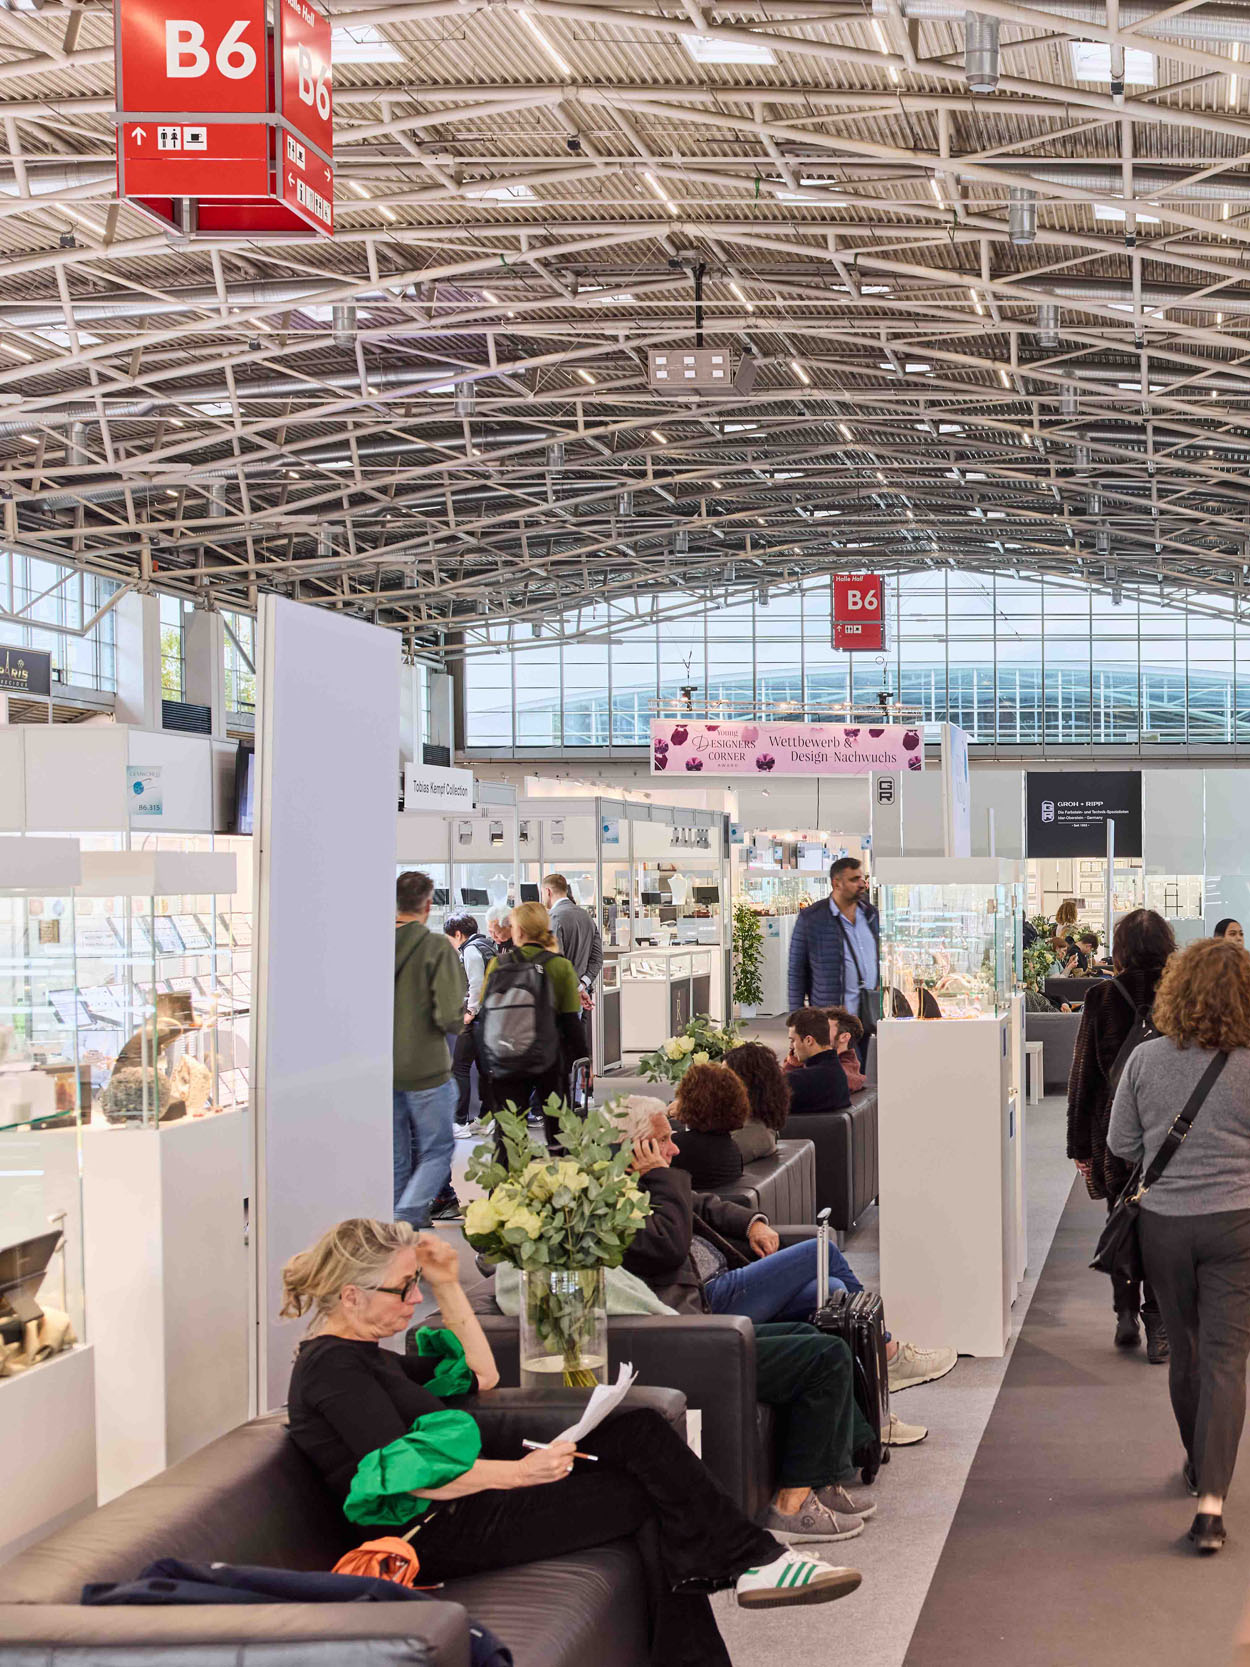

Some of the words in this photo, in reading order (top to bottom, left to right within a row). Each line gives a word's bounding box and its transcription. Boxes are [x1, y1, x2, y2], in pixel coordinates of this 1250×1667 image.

[302, 4, 315, 28] Hall
[165, 20, 257, 79] B6
[298, 42, 330, 121] B6
[847, 590, 878, 610] B6
[717, 729, 739, 737] Young
[768, 735, 841, 748] Wettbewerb
[843, 737, 853, 748] &
[691, 734, 756, 752] DESIGNERS
[708, 752, 746, 761] CORNER
[413, 780, 430, 793] Tobias
[446, 783, 468, 796] Collection
